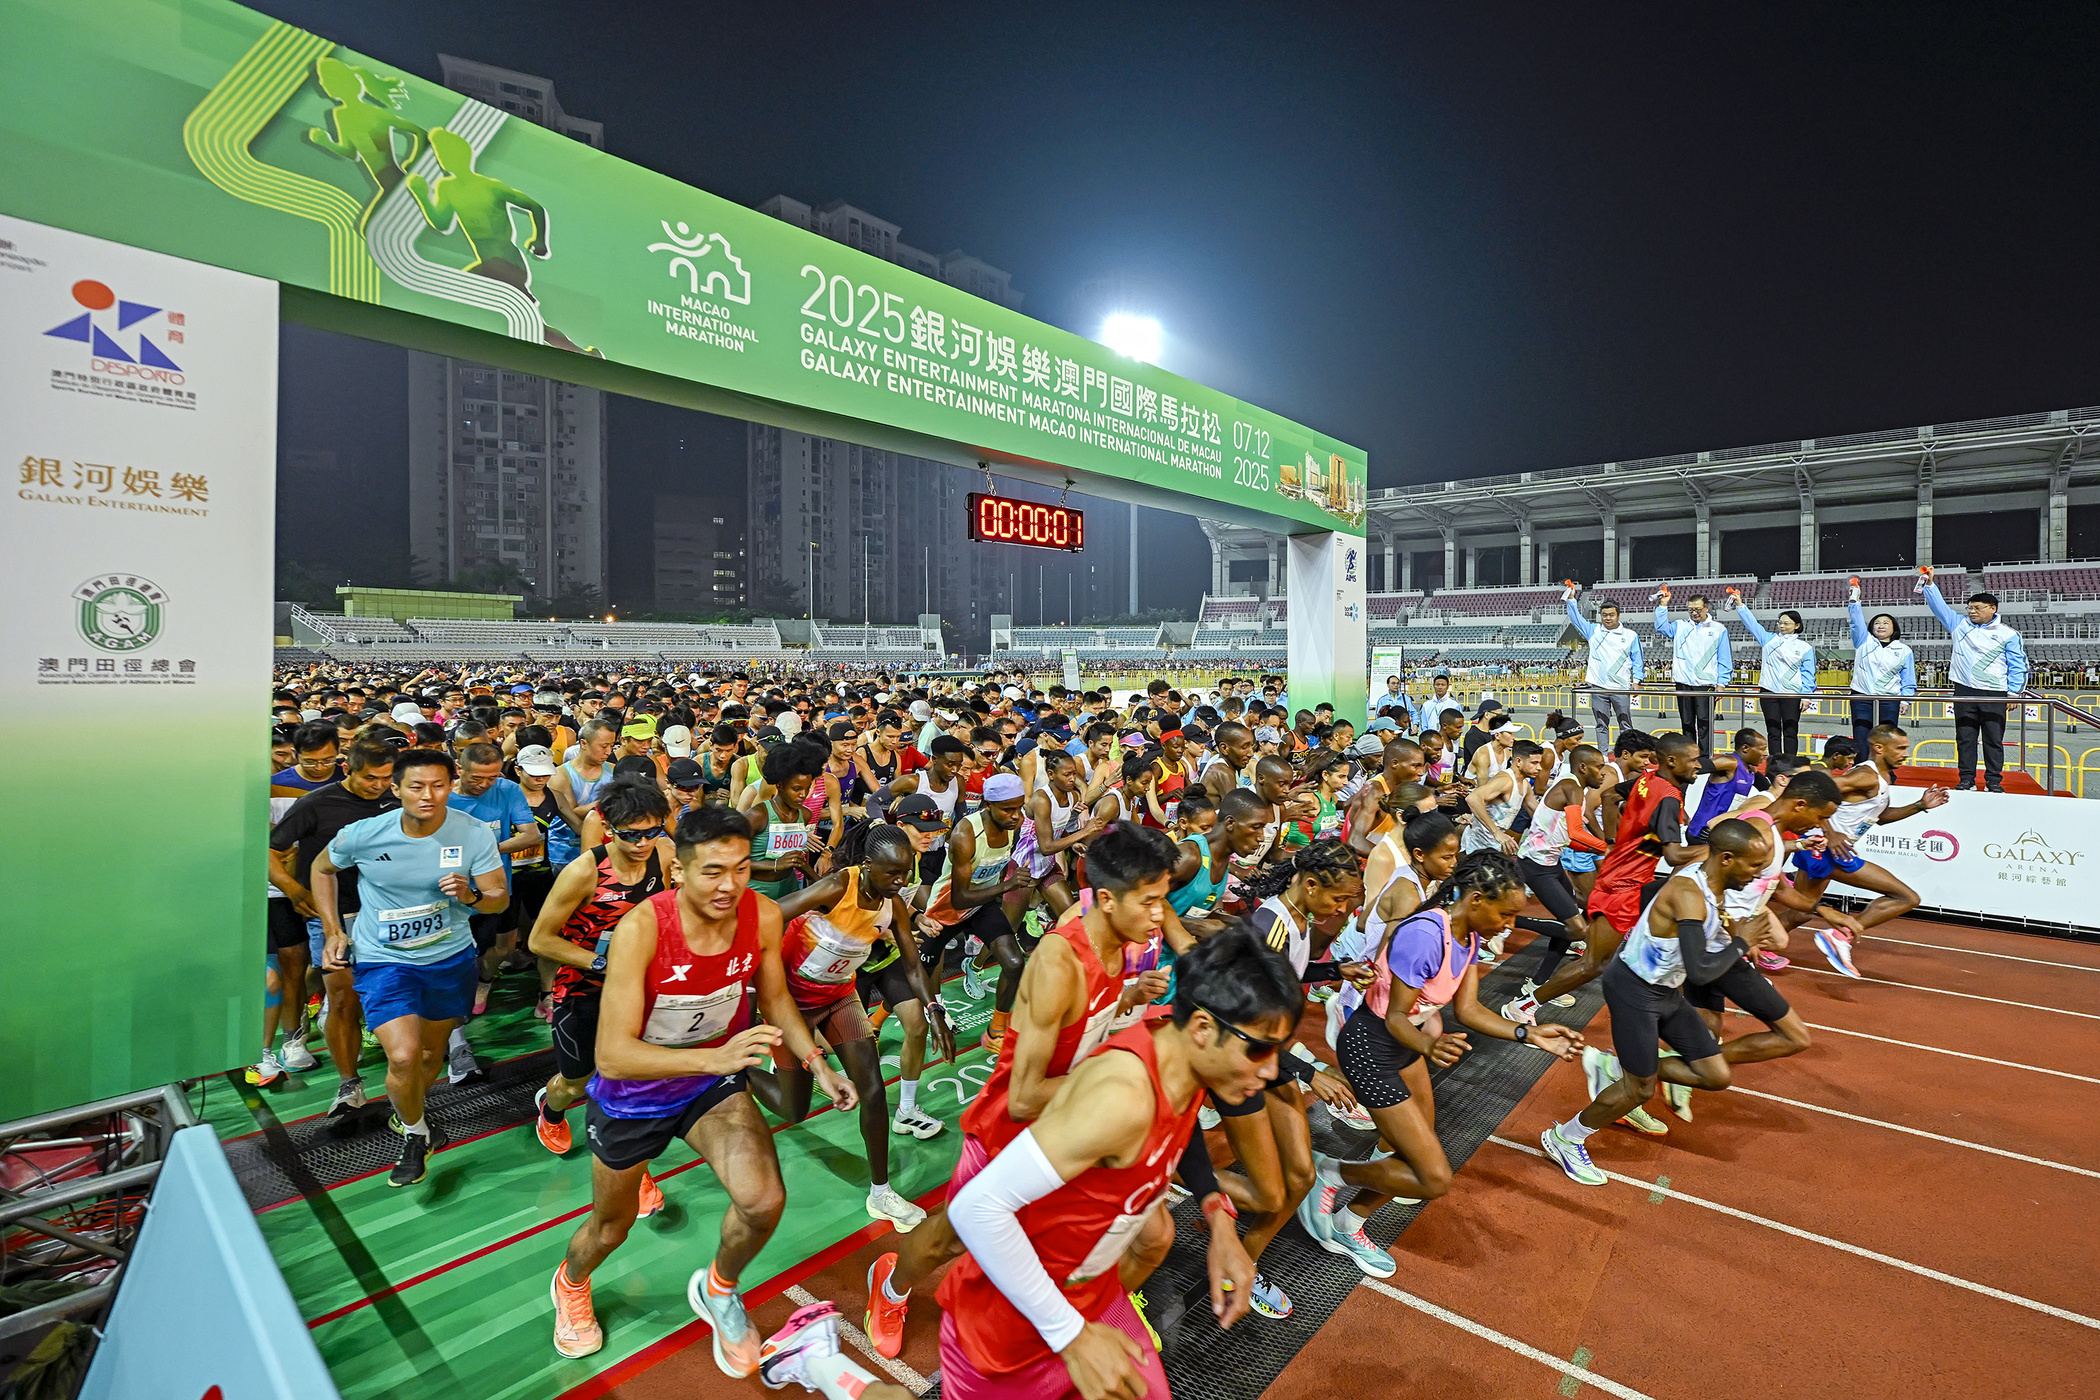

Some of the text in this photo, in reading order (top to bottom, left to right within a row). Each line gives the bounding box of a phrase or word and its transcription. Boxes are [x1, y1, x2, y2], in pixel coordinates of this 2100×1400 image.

[681, 294, 730, 320] MACAO
[647, 299, 759, 343] INTERNATIONAL
[666, 320, 744, 353] MARATHON
[801, 323, 1222, 463] GALAXY ENTERTAINMENT MARATONA INTERNACIONAL DE MACAU
[801, 348, 1222, 480] GALAXY ENTERTAINMENT MACAO INTERNATIONAL MARATHON
[1233, 420, 1270, 460] 07.12
[18, 456, 209, 503] 銀河娛樂
[1233, 456, 1269, 492] 2025
[18, 488, 209, 518] GALAXY ENTERTAINMENT
[981, 498, 1082, 545] 00:00:01
[88, 632, 153, 648] AGAM
[37, 657, 196, 673] 澳門田徑總會
[774, 833, 804, 849] B6602
[1866, 833, 1944, 853] 澳門百老匯
[2005, 863, 2059, 874] ARENA
[388, 914, 443, 941] B2993
[726, 952, 753, 976] 北京
[827, 958, 850, 974] 62
[687, 1012, 705, 1033] 2
